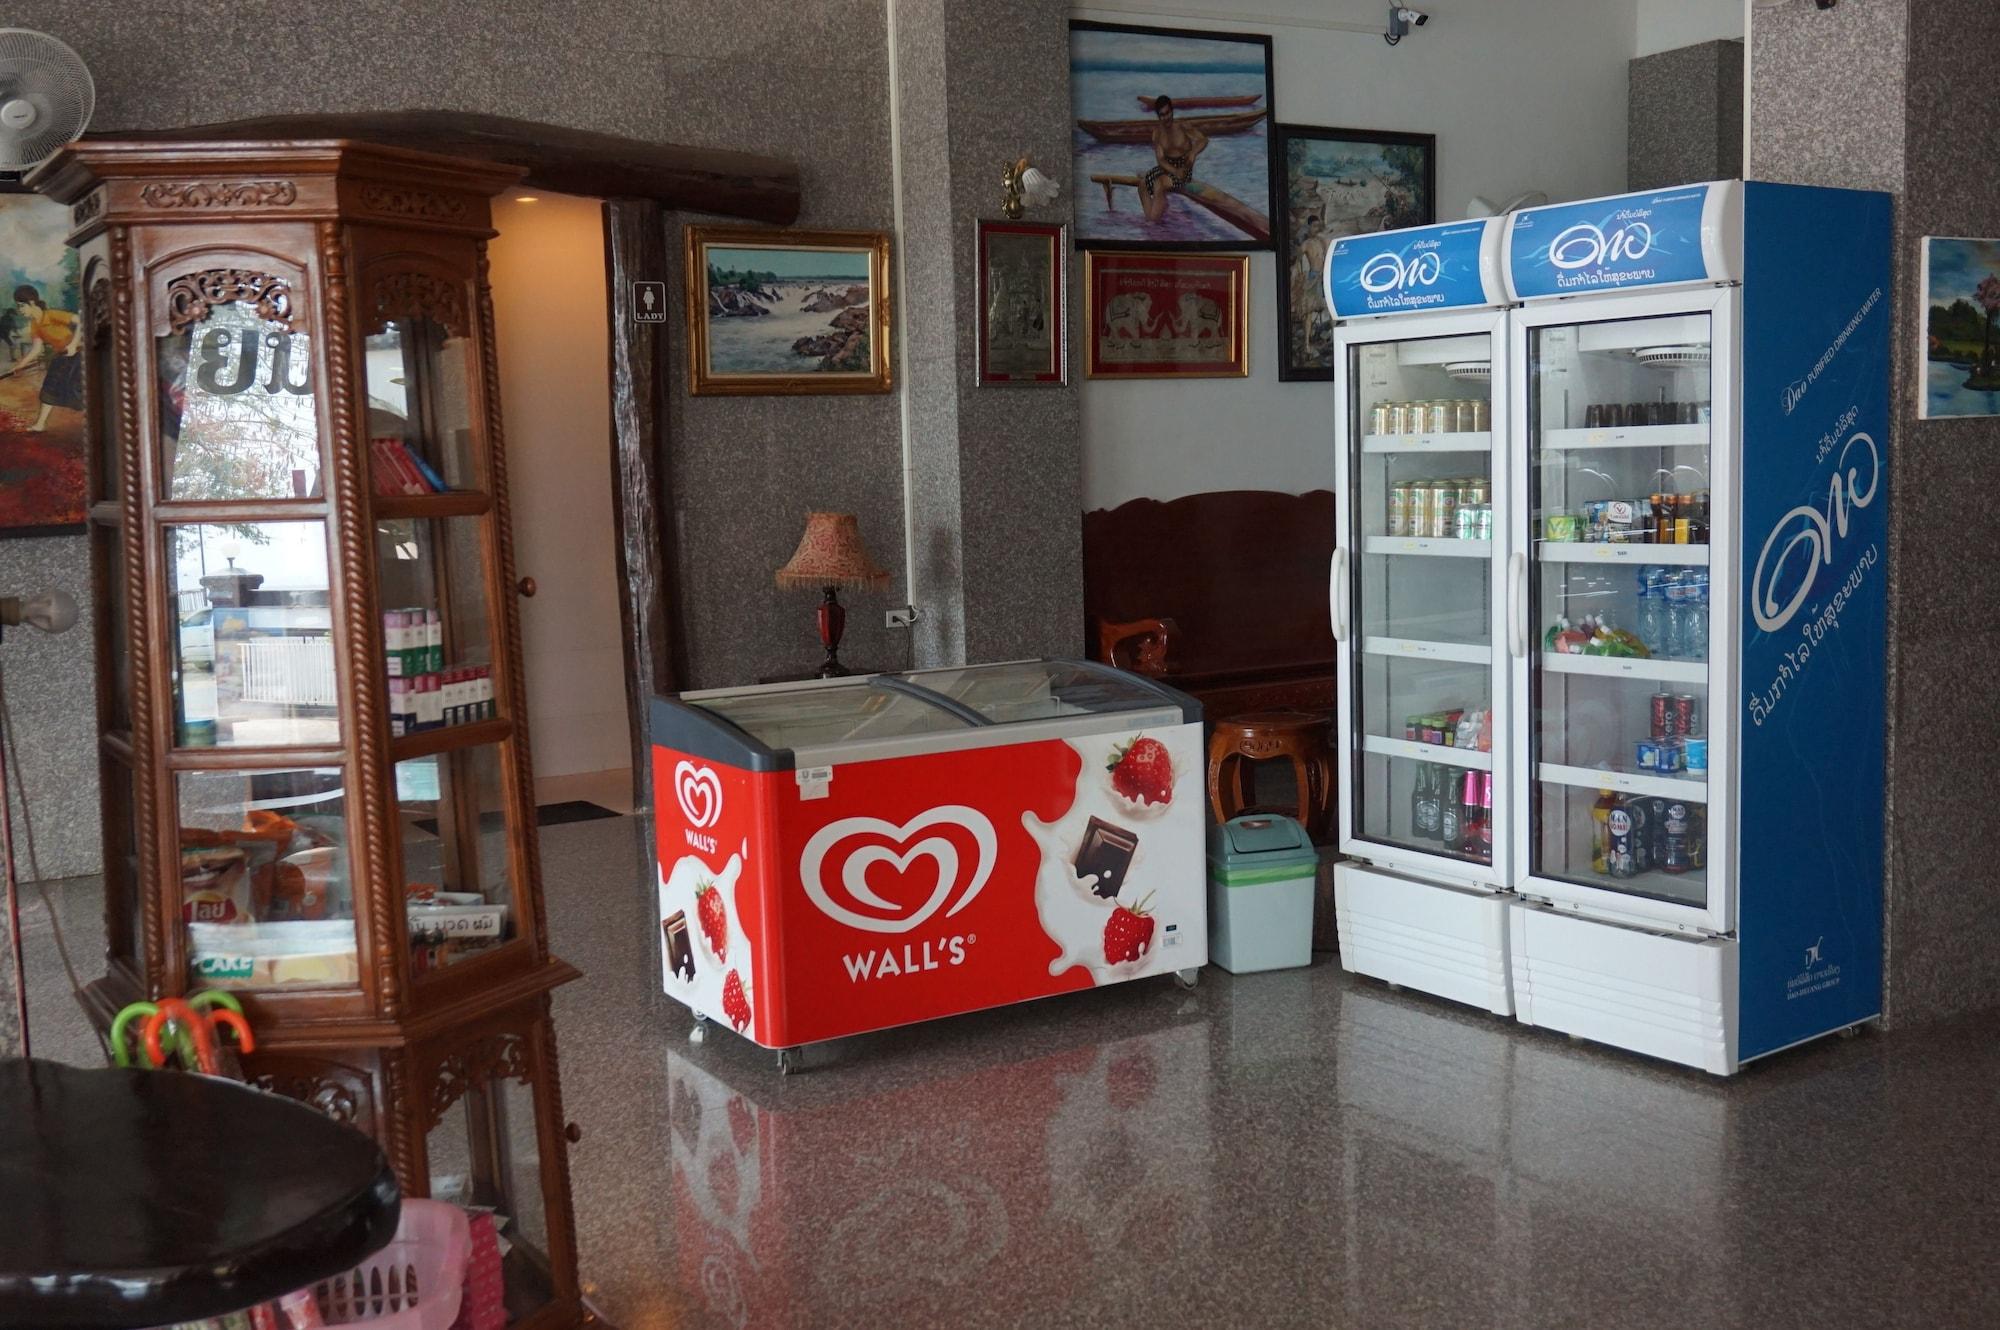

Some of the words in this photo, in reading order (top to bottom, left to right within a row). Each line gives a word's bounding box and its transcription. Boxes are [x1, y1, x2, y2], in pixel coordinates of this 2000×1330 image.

[636, 312, 664, 320] LADY
[1807, 346, 1835, 385] PURIFIED
[1833, 311, 1863, 352] DRINKING
[1860, 287, 1882, 316] WATER
[684, 828, 717, 854] WALL'S
[842, 934, 967, 983] WALL'S
